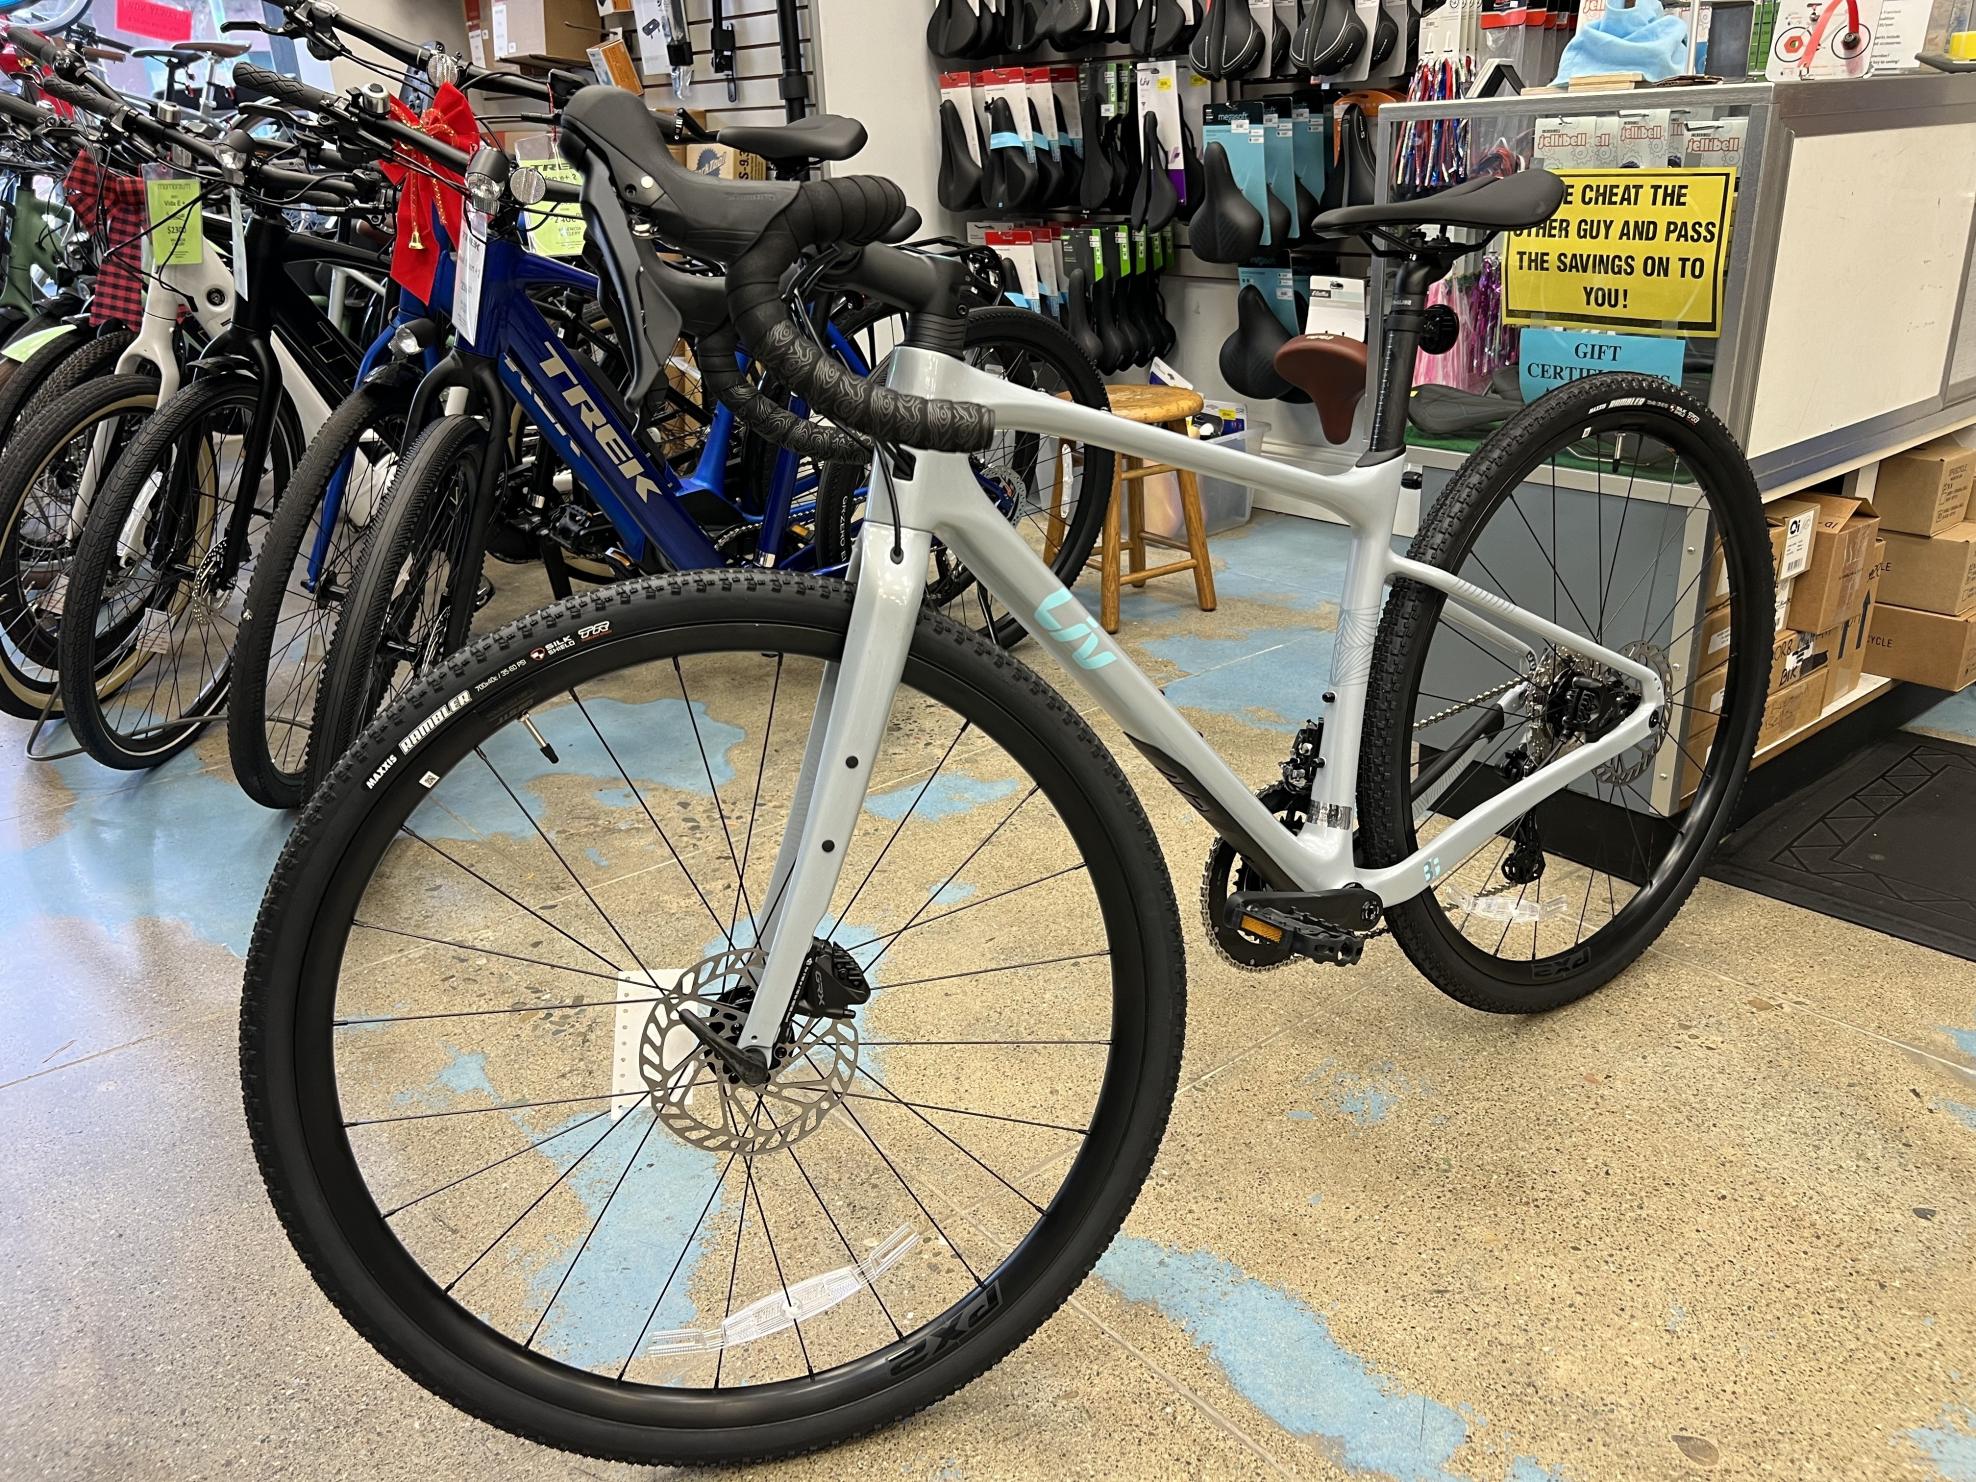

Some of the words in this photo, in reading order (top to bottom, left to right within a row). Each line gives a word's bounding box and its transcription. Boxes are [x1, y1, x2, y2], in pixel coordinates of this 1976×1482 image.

[1538, 132, 1587, 149] jellibell
[1620, 125, 1662, 141] jellibell
[1686, 137, 1740, 153] jellibell
[1581, 184, 1643, 206] CHEAT
[1650, 184, 1689, 207] THE
[1577, 219, 1615, 240] GUY
[1618, 220, 1657, 242] AND
[1664, 221, 1717, 243] PASS
[1517, 250, 1550, 272] THE
[1556, 252, 1635, 276] SAVINGS
[1643, 255, 1669, 278] ON
[1678, 257, 1705, 280] TO
[1574, 342, 1622, 362] GIFT
[534, 341, 663, 503] TREK
[544, 635, 572, 651] SILK
[547, 640, 576, 656] SHIELD
[516, 659, 527, 668] PSI
[398, 689, 473, 756] RAMBLER
[365, 754, 398, 790] MAXXIS
[815, 970, 826, 1007] GRX
